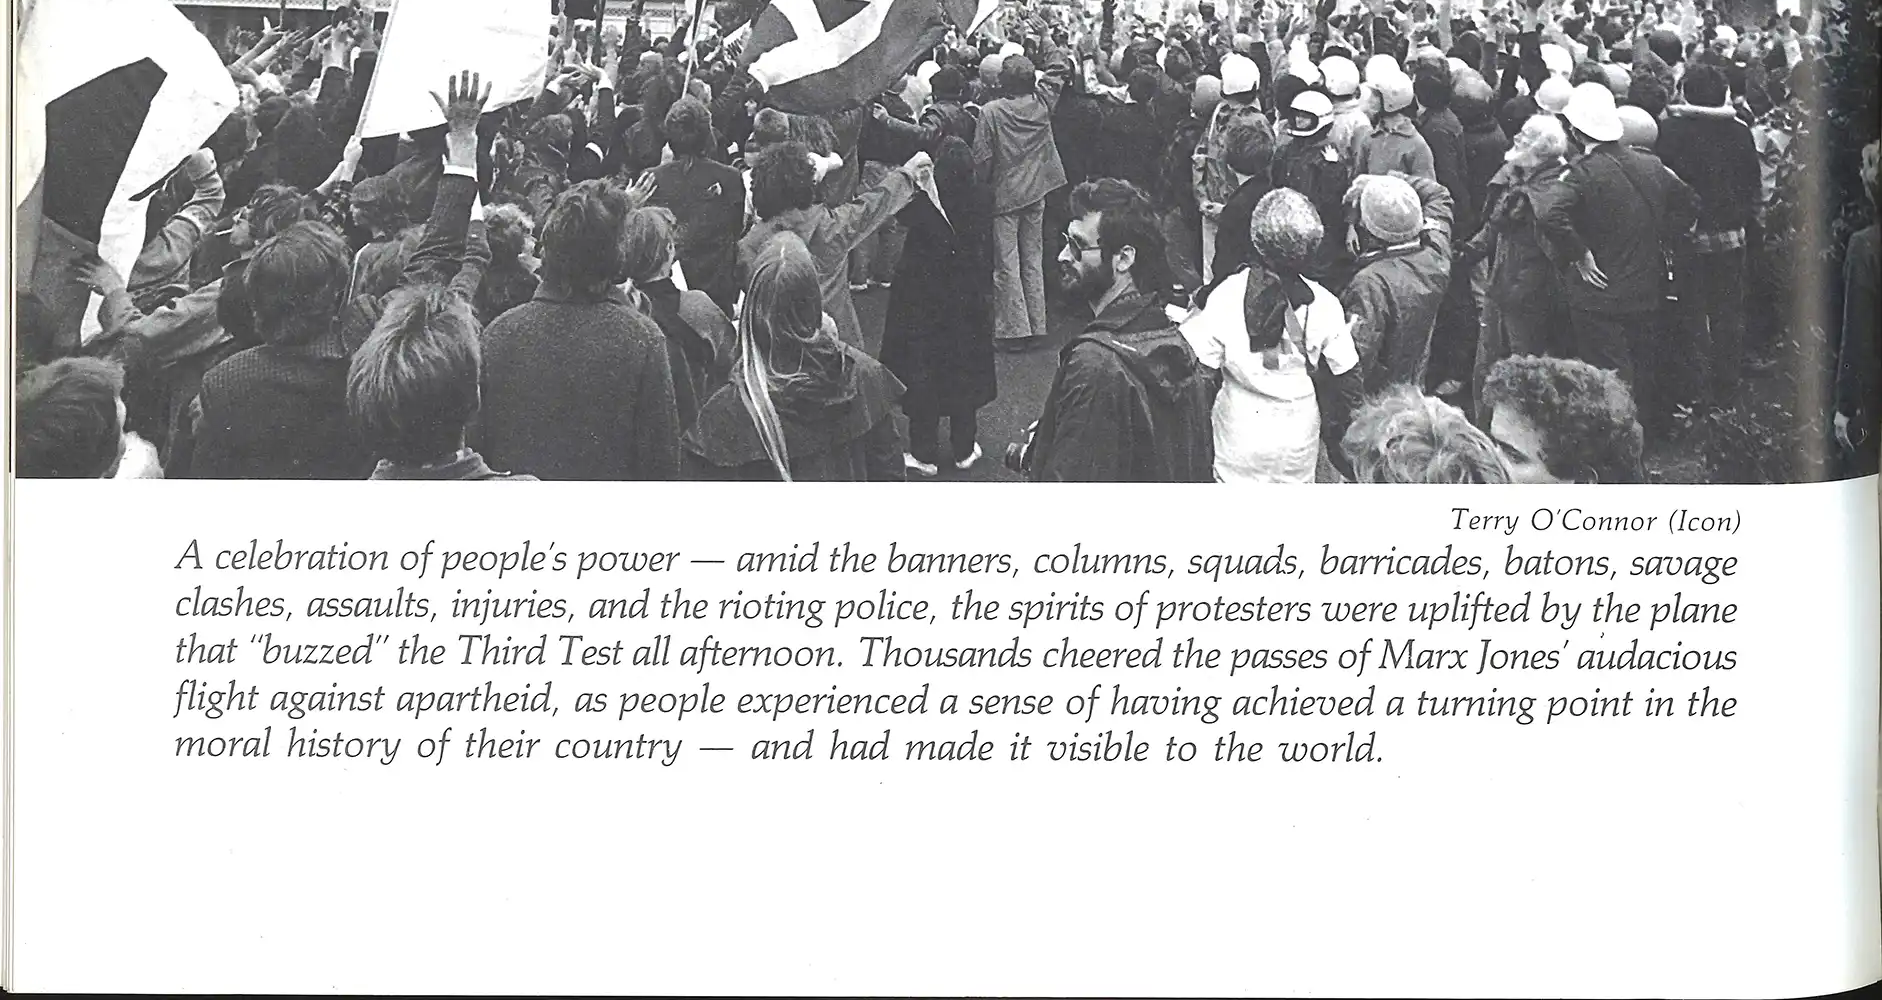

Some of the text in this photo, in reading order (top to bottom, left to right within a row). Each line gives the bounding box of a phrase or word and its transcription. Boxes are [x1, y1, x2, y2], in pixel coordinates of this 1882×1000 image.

[1451, 507, 1741, 536] Terry O'Connor (Icon)
[173, 538, 203, 570] A
[215, 538, 389, 571] celebration
[400, 539, 435, 579] of
[440, 539, 567, 580] people's
[576, 551, 681, 580] power
[736, 541, 820, 573] amid
[829, 541, 877, 573] the
[887, 541, 1019, 579] banners,
[1033, 542, 1174, 579] columns,
[1187, 543, 1305, 583] squads,
[1320, 543, 1489, 580] barricades,
[1504, 544, 1617, 581] batons,
[1629, 556, 1738, 585] savage
[175, 584, 1738, 631] clashes, assaults, injuries, and the rioting police, the spirits of protesters were uplifted by the plane
[176, 632, 1737, 678] that "buzzed" the Third Test all afternoon. Thousands cheered the passes of Marx Jones' audacious
[172, 678, 1738, 726] flight against apartheid, as people experienced a sense of having achieved a turning point in the
[175, 725, 272, 758] moral
[287, 726, 402, 766] history
[417, 726, 453, 767] of
[465, 726, 541, 759] their
[555, 733, 683, 767] country
[751, 728, 815, 760] and
[829, 728, 891, 761] had
[905, 729, 994, 761] made
[1009, 731, 1033, 761] it
[1046, 730, 1150, 762] visible
[1166, 736, 1197, 762] to
[1214, 730, 1263, 762] the
[1277, 730, 1382, 763] world.
